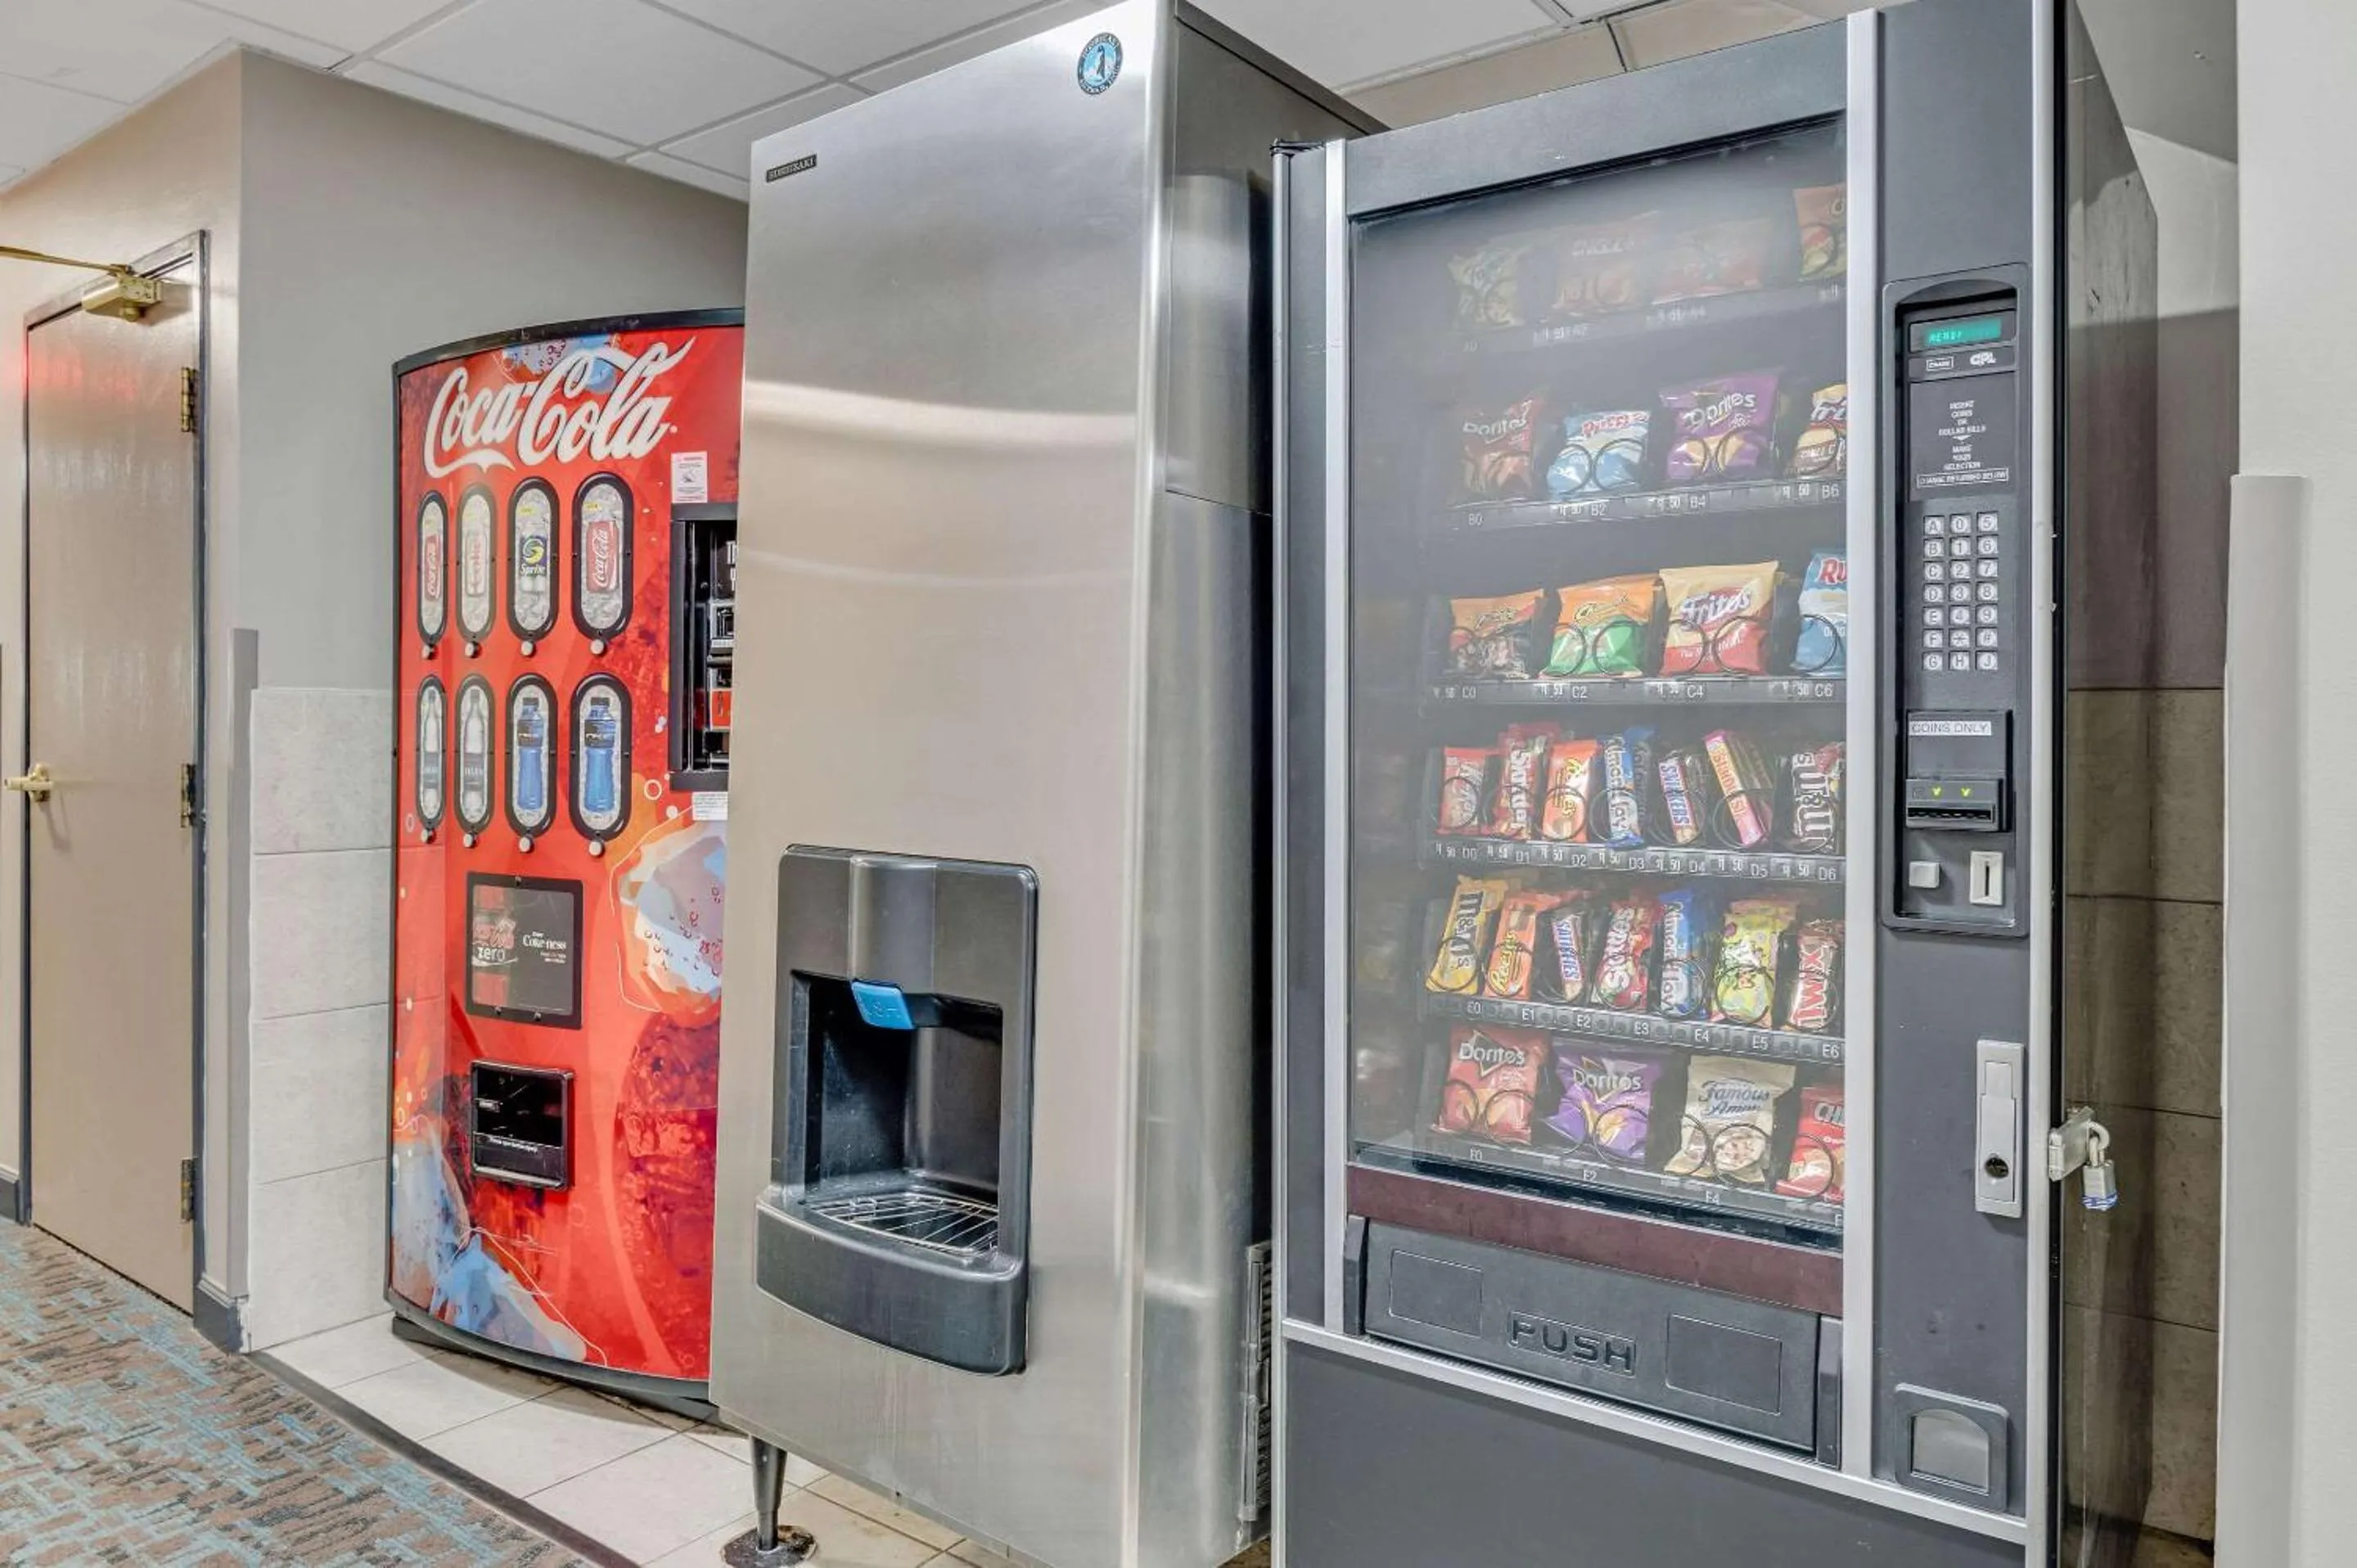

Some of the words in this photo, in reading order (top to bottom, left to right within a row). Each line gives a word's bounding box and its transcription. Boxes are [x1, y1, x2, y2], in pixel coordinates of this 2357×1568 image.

[424, 336, 696, 479] Coca-Cola
[1681, 393, 1756, 434] Doritos
[1822, 484, 1840, 499] B6
[1591, 503, 1607, 516] B2
[1679, 587, 1751, 631] Fritos
[1687, 684, 1704, 698] C4
[1814, 683, 1833, 697] C6
[1912, 722, 1950, 733] COINS
[1954, 722, 1989, 733] ONLY
[1572, 854, 1587, 867] D2
[1629, 857, 1645, 870] D3
[1751, 863, 1769, 878] D5
[1818, 866, 1836, 881] D6
[1521, 1008, 1535, 1021] E1
[1576, 1015, 1591, 1029] E2
[1634, 1022, 1650, 1035] E3
[1458, 1043, 1526, 1066] Doritos
[1822, 1043, 1840, 1058] E6
[1573, 1068, 1643, 1090] Doritos
[1512, 1318, 1633, 1373] PUSH
